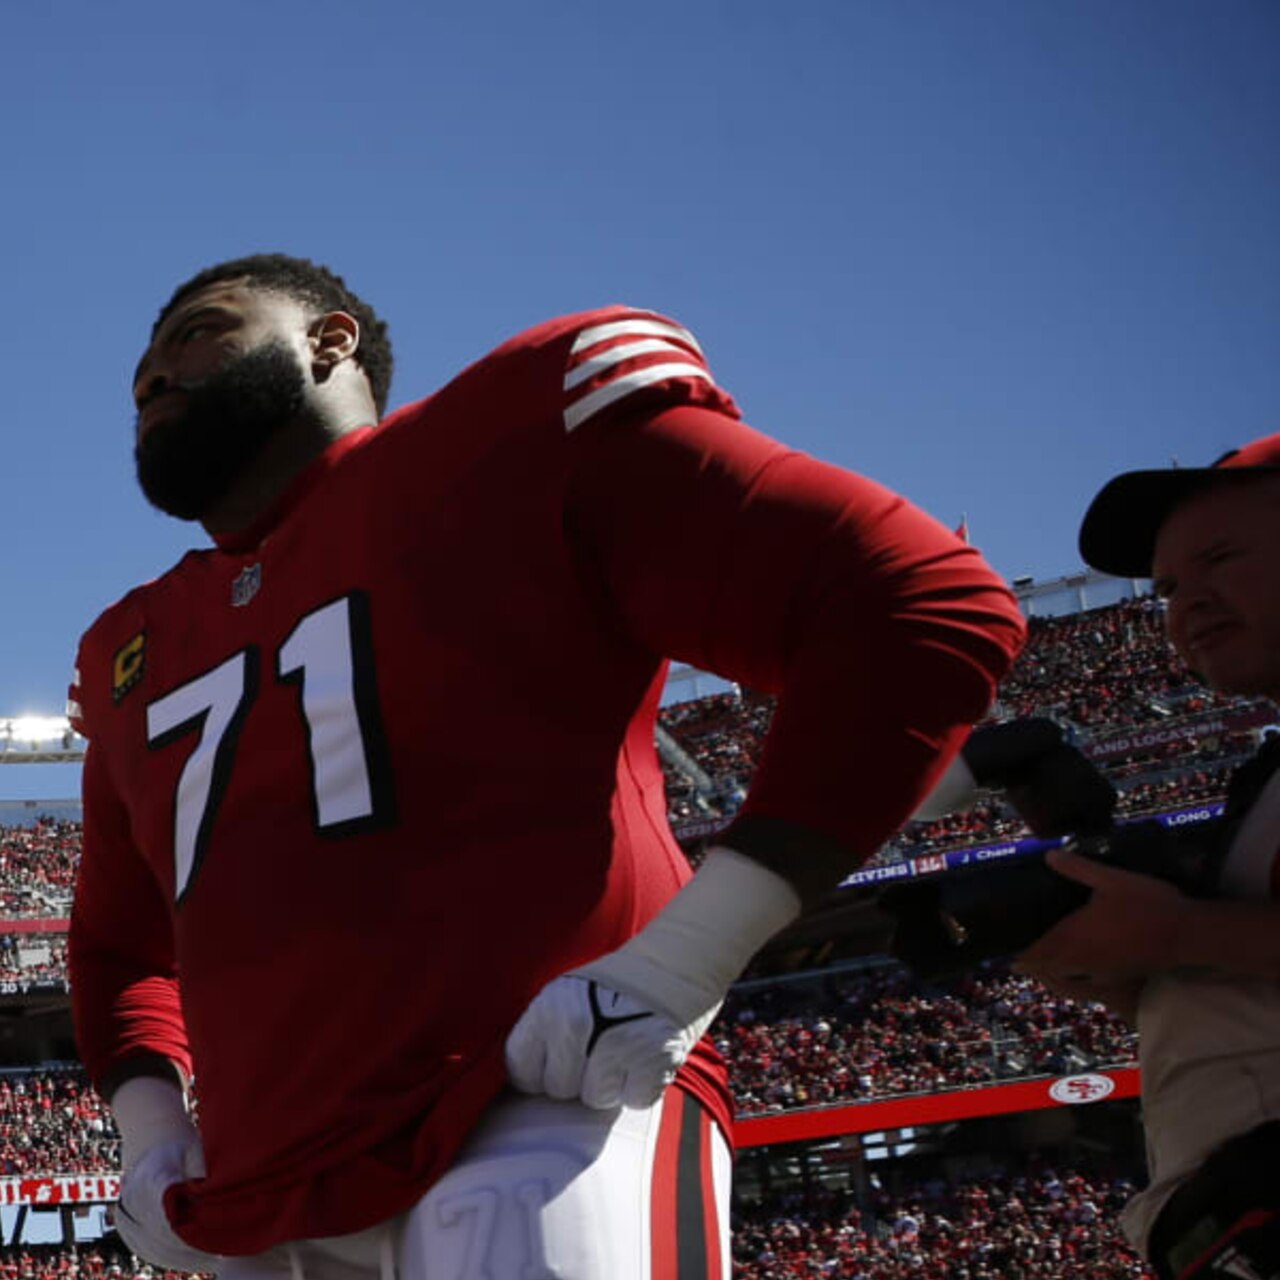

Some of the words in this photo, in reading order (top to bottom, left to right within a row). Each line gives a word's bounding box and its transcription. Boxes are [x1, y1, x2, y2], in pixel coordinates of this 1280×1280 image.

[114, 634, 144, 688] C
[147, 597, 373, 902] 71
[1093, 740, 1130, 755] AND
[1168, 811, 1210, 826] LONG
